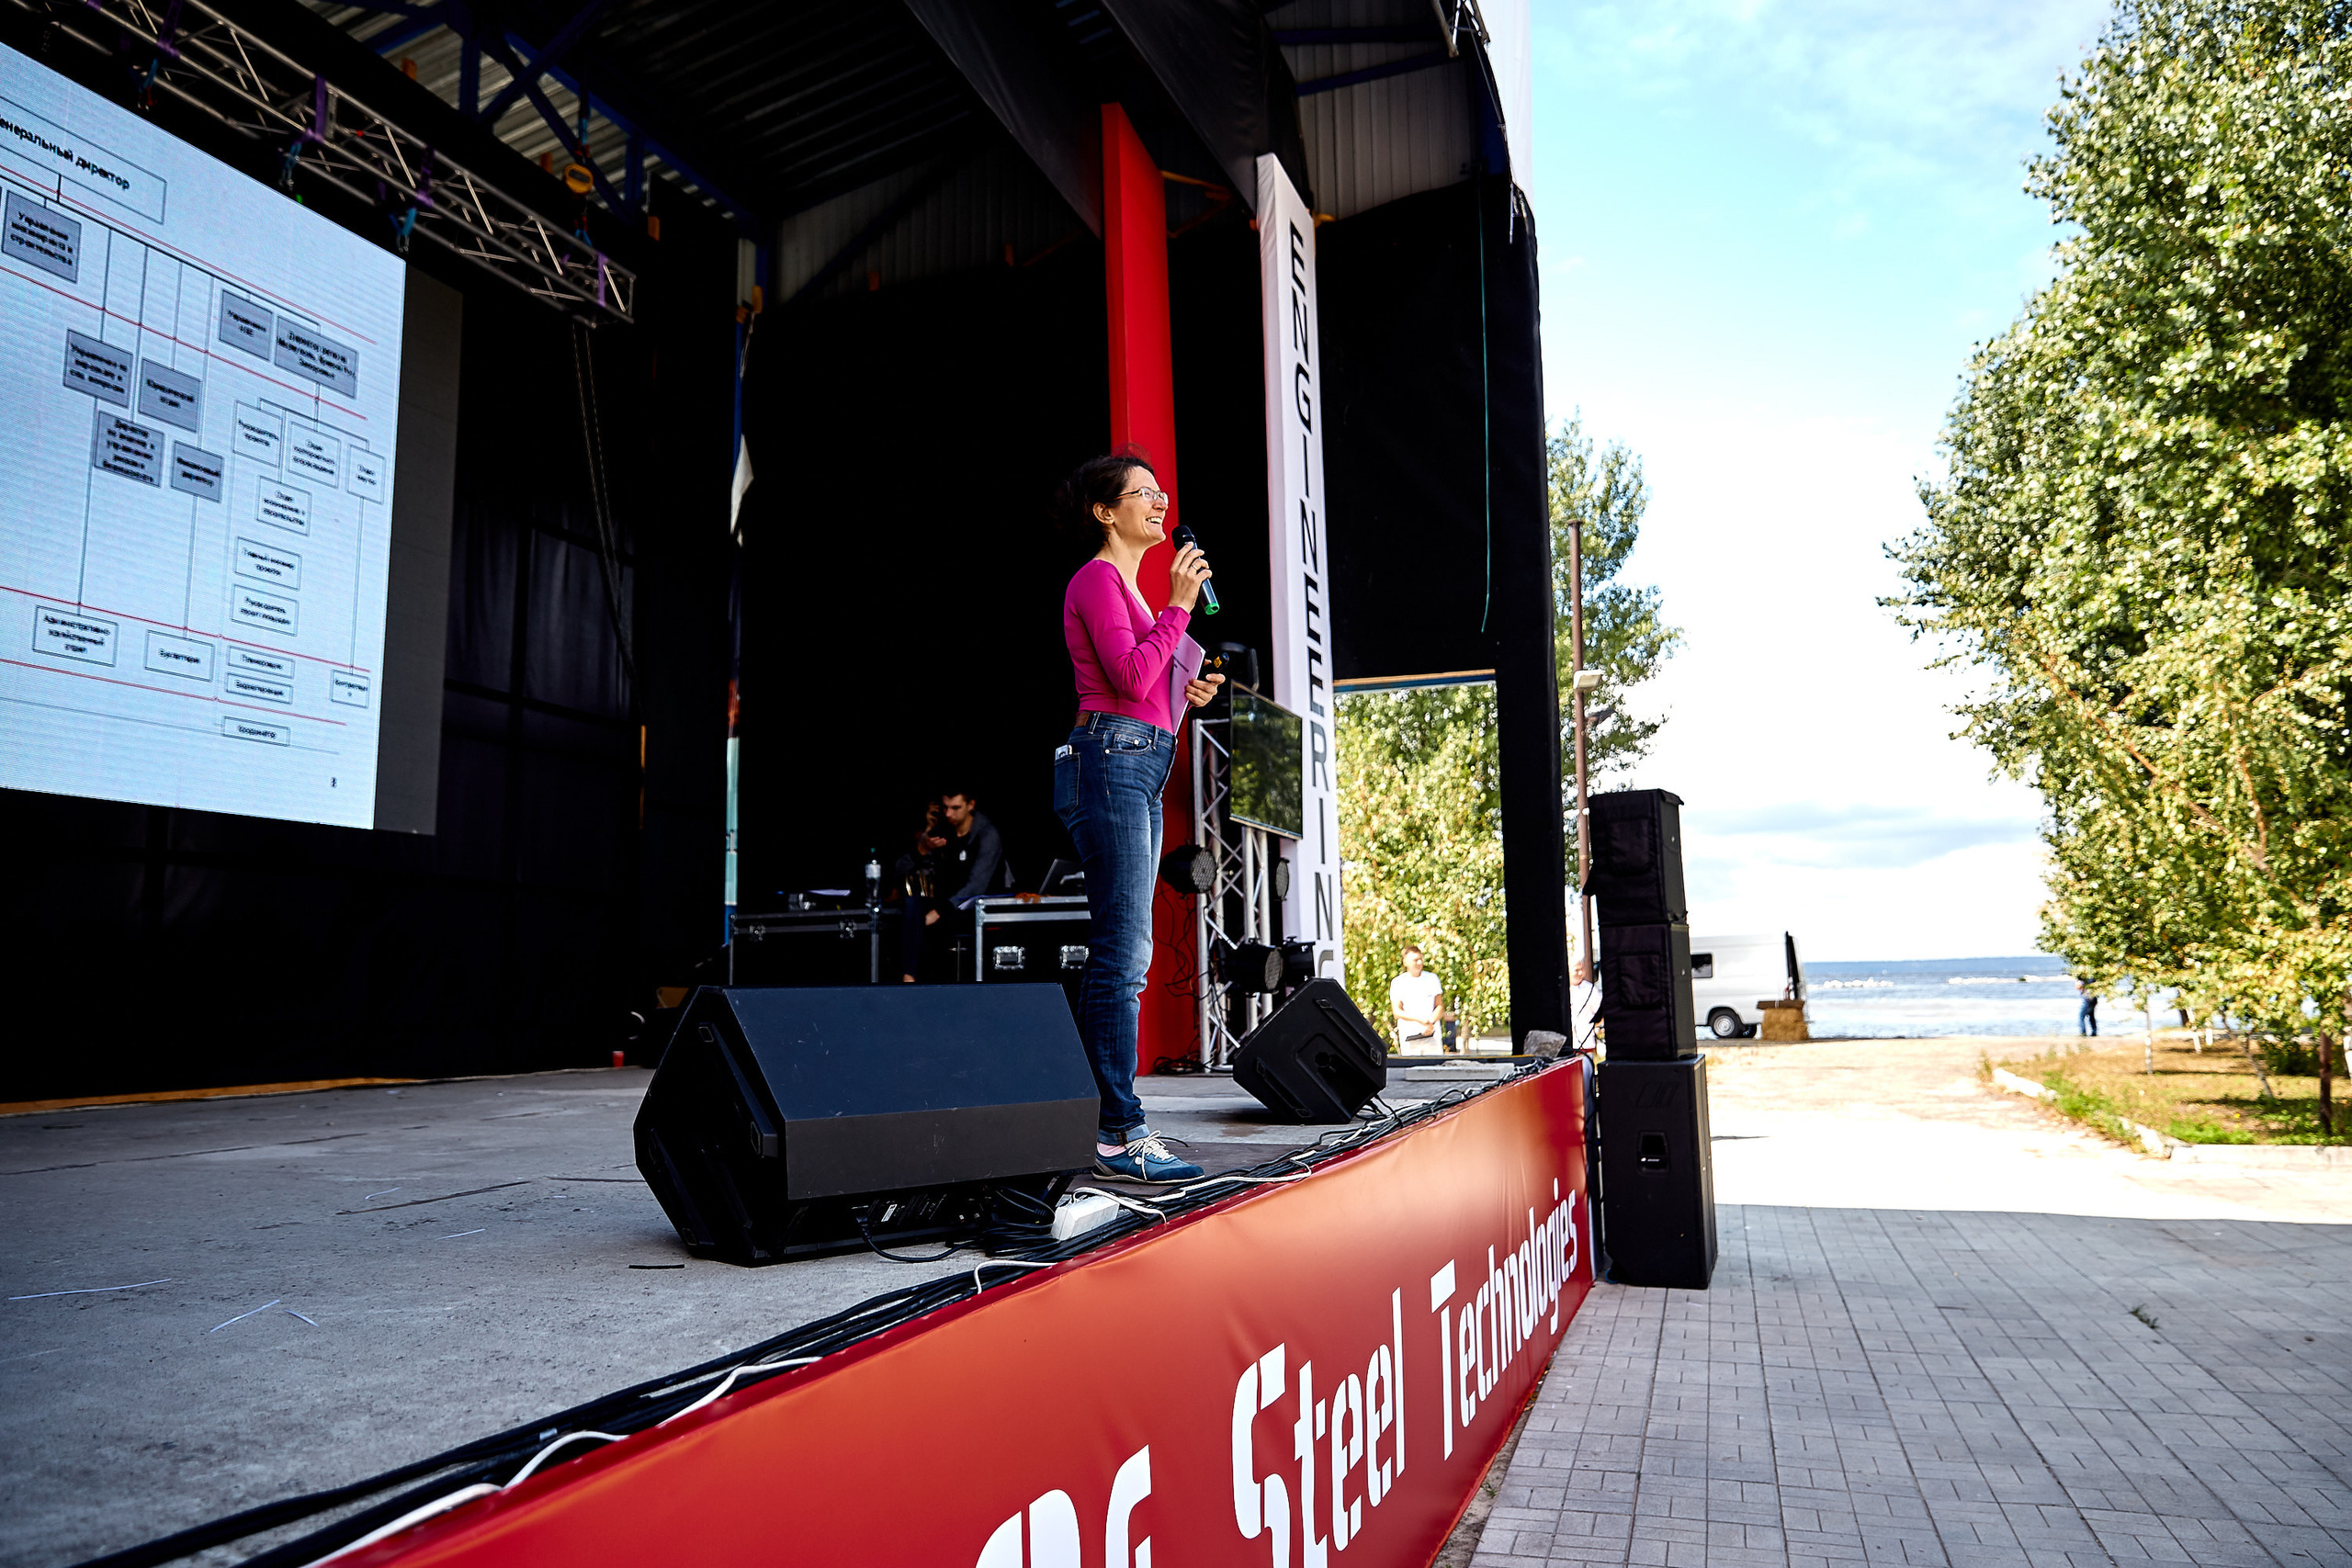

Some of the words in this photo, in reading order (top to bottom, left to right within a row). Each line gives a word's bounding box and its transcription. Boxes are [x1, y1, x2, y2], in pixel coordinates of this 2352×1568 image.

[0, 115, 74, 162] енеральный
[1232, 1287, 1406, 1568] Steel
[1430, 1178, 1577, 1461] Technologies
